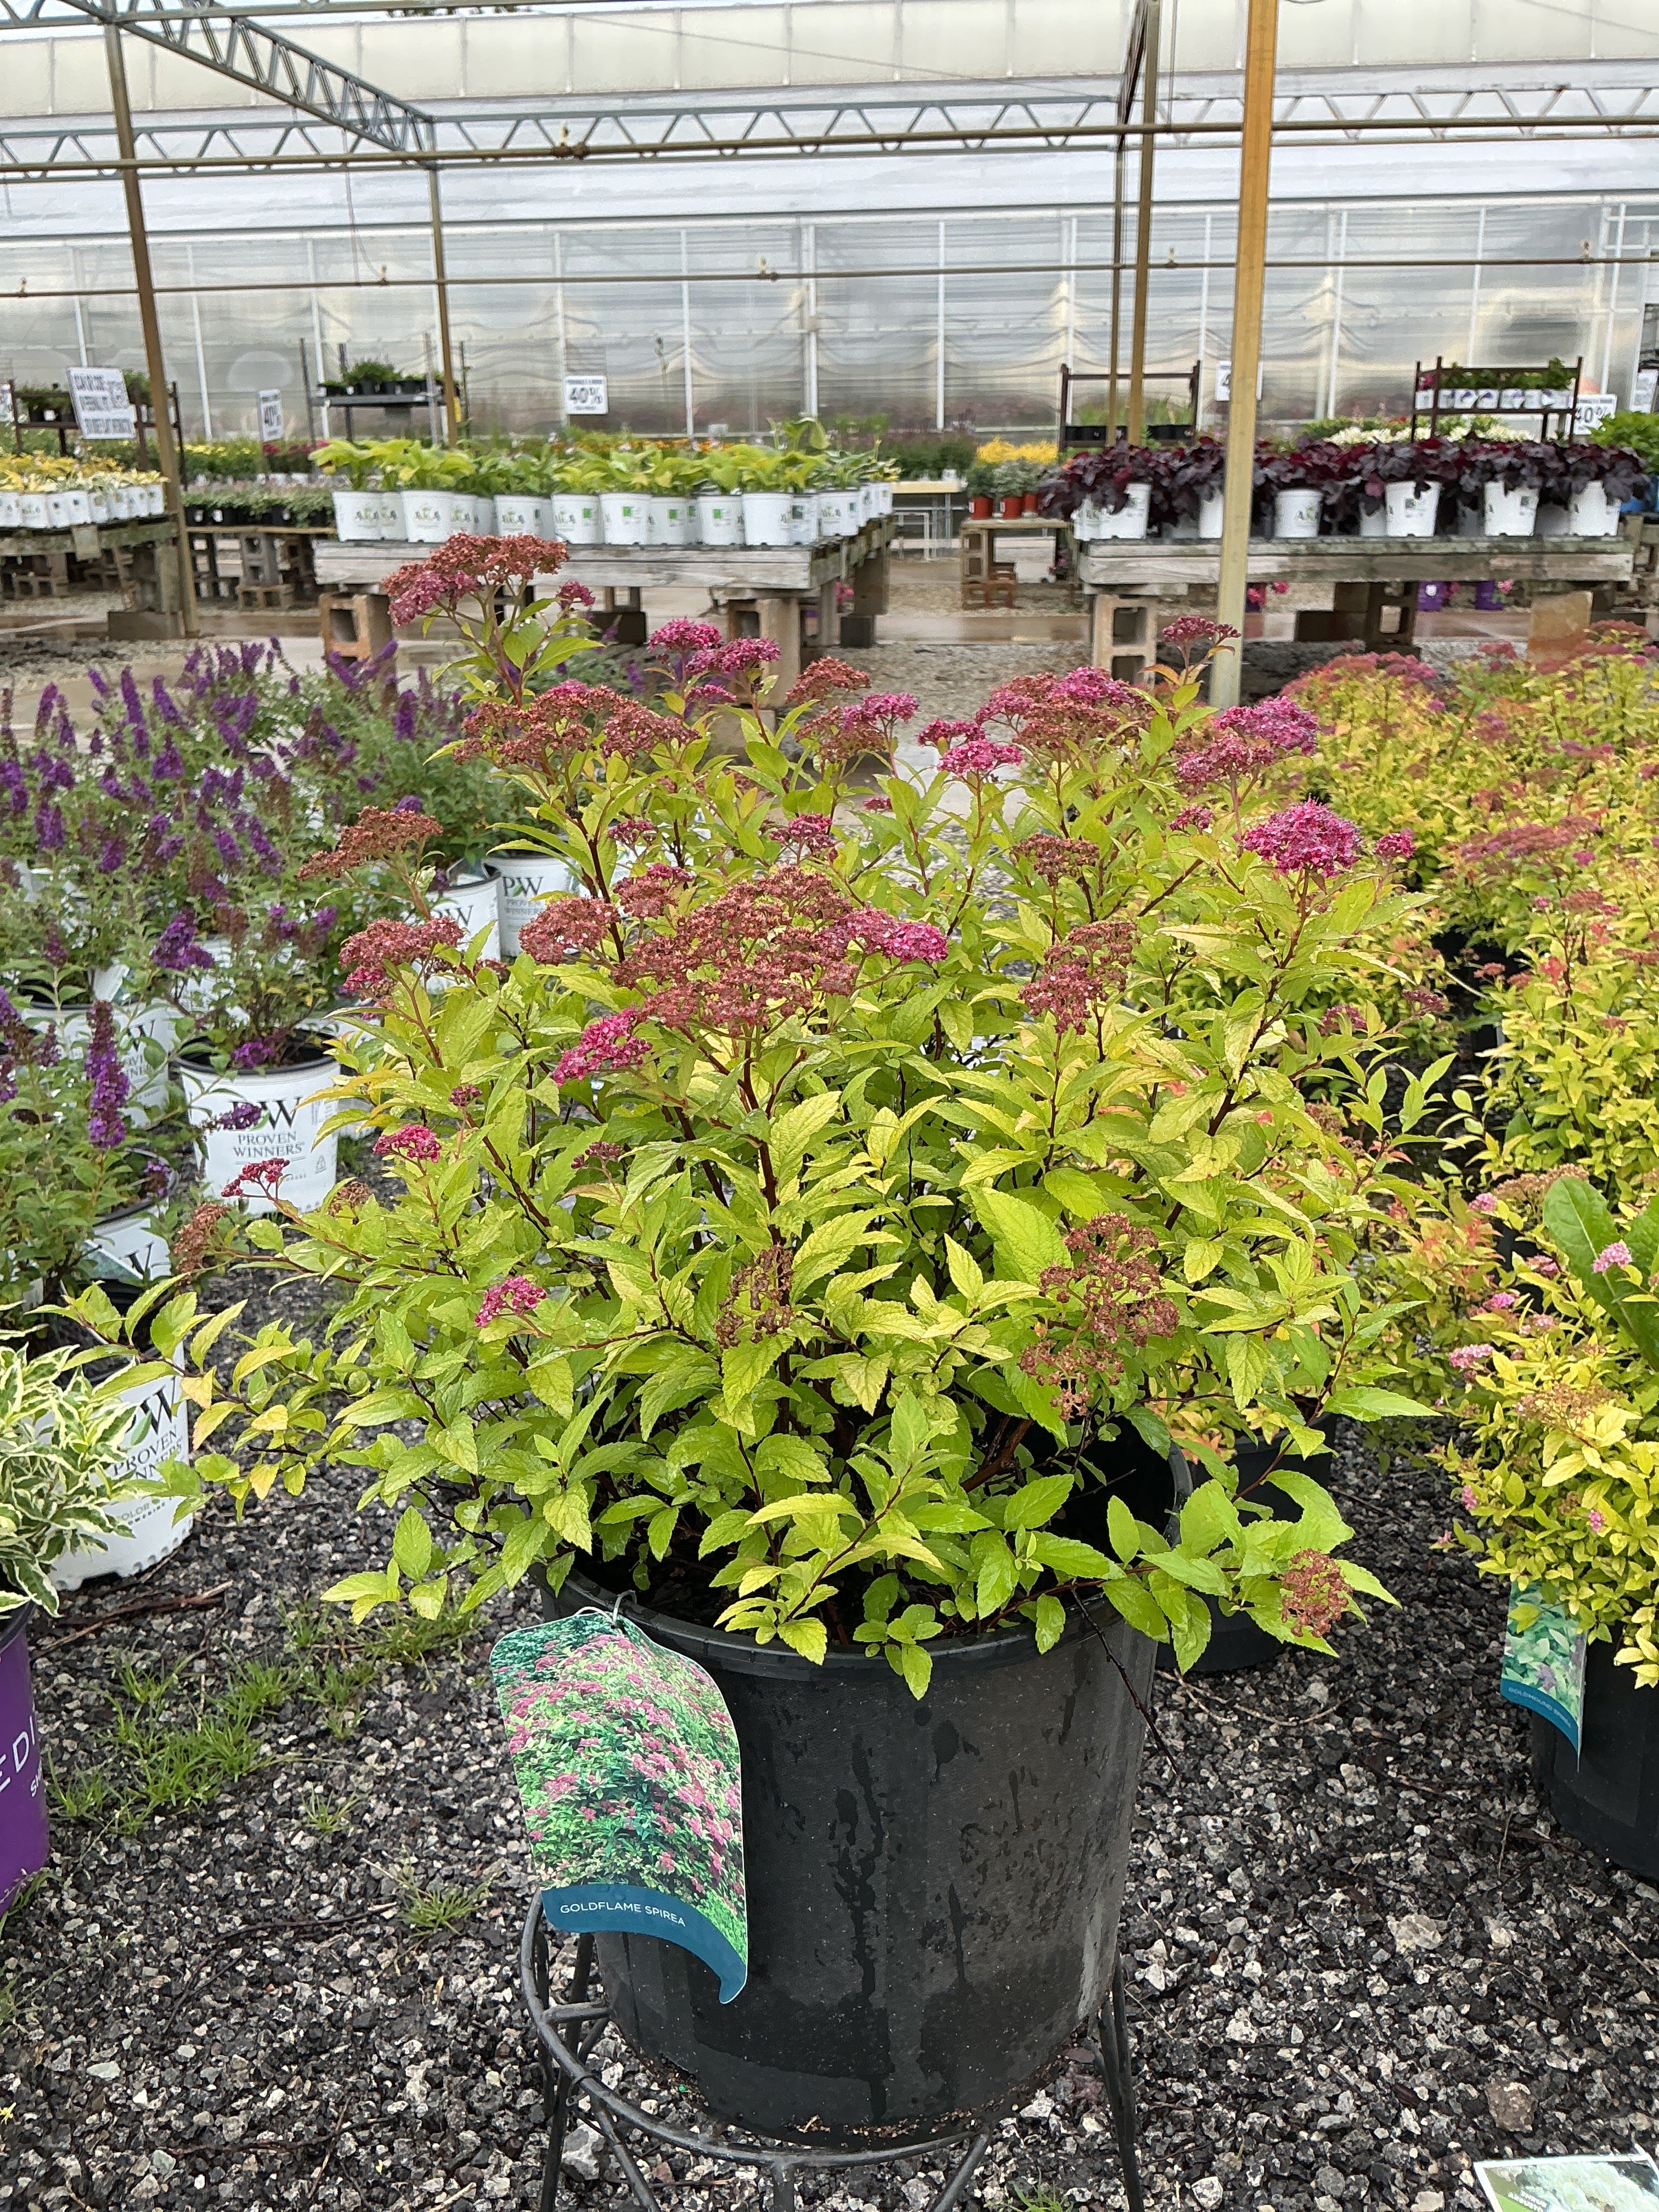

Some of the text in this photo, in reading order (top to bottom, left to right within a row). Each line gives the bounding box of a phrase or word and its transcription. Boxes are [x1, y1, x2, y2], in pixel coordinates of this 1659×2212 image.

[569, 387, 603, 404] 40%
[501, 876, 545, 898] PW
[237, 1131, 297, 1146] PROVEN
[233, 1142, 303, 1158] WINNERS
[114, 1425, 177, 1476] PROVEN
[120, 1502, 150, 1521] OLOR
[560, 1901, 686, 1927] GOLDFLAME SPIREA
